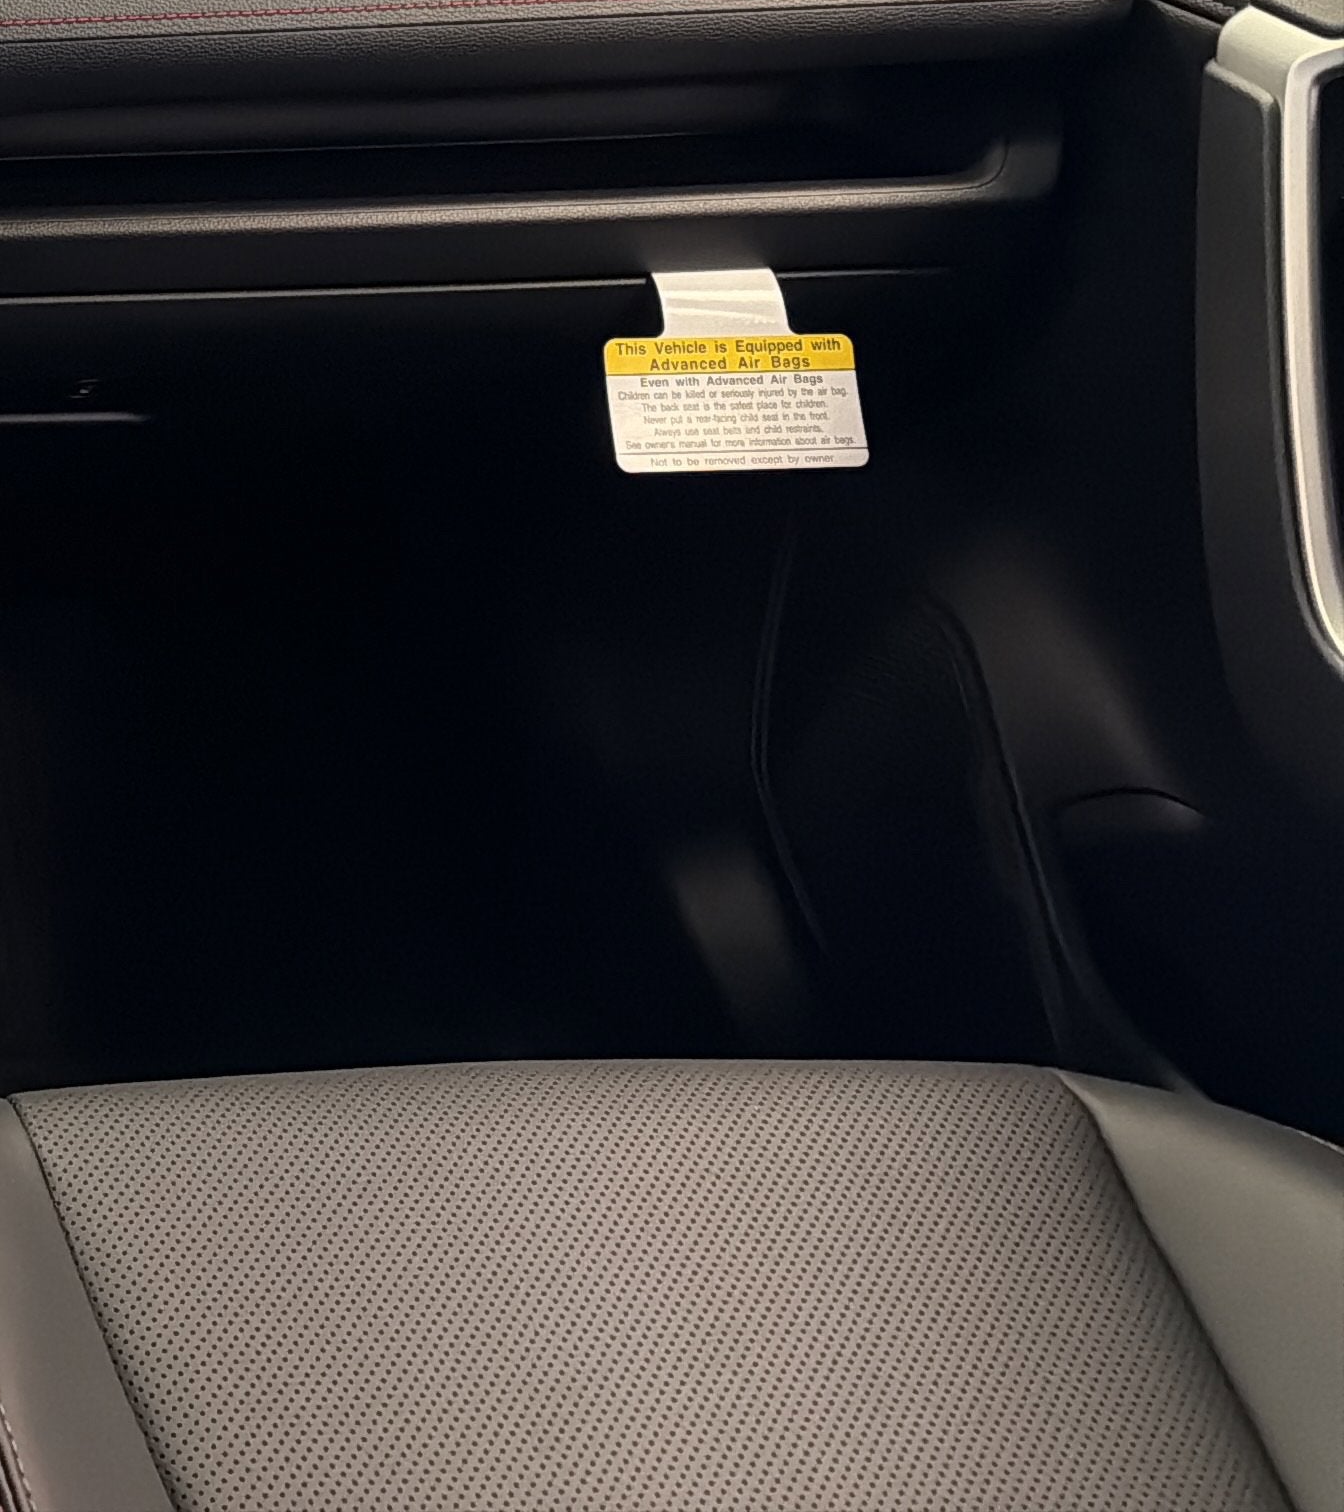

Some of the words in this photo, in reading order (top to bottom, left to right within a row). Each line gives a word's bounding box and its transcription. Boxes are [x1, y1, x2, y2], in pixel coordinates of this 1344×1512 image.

[615, 342, 647, 355] This
[654, 341, 707, 355] Vehicle
[714, 340, 728, 353] is
[735, 339, 803, 355] Equipped
[811, 338, 841, 351] with
[650, 357, 727, 371] Advanced
[738, 356, 761, 369] Air
[771, 356, 811, 369] Bags
[640, 377, 670, 388] Even
[675, 376, 700, 387] with
[706, 375, 764, 386] Advanced
[770, 374, 788, 385] Air
[793, 374, 824, 386] Bags
[618, 390, 651, 401] Children
[654, 391, 669, 400] can
[672, 390, 682, 400] be
[685, 389, 706, 399] killed
[709, 390, 717, 399] or
[721, 389, 755, 400] seriously
[758, 388, 785, 399] injured
[788, 388, 798, 398] by
[801, 387, 813, 396] the
[818, 387, 828, 395] air
[831, 386, 849, 397] bag.
[650, 457, 668, 467] Not
[672, 457, 683, 466] to
[686, 456, 700, 466] be
[704, 456, 746, 465] removed
[751, 455, 784, 466] except
[787, 454, 800, 465] by
[804, 454, 834, 463] owner
